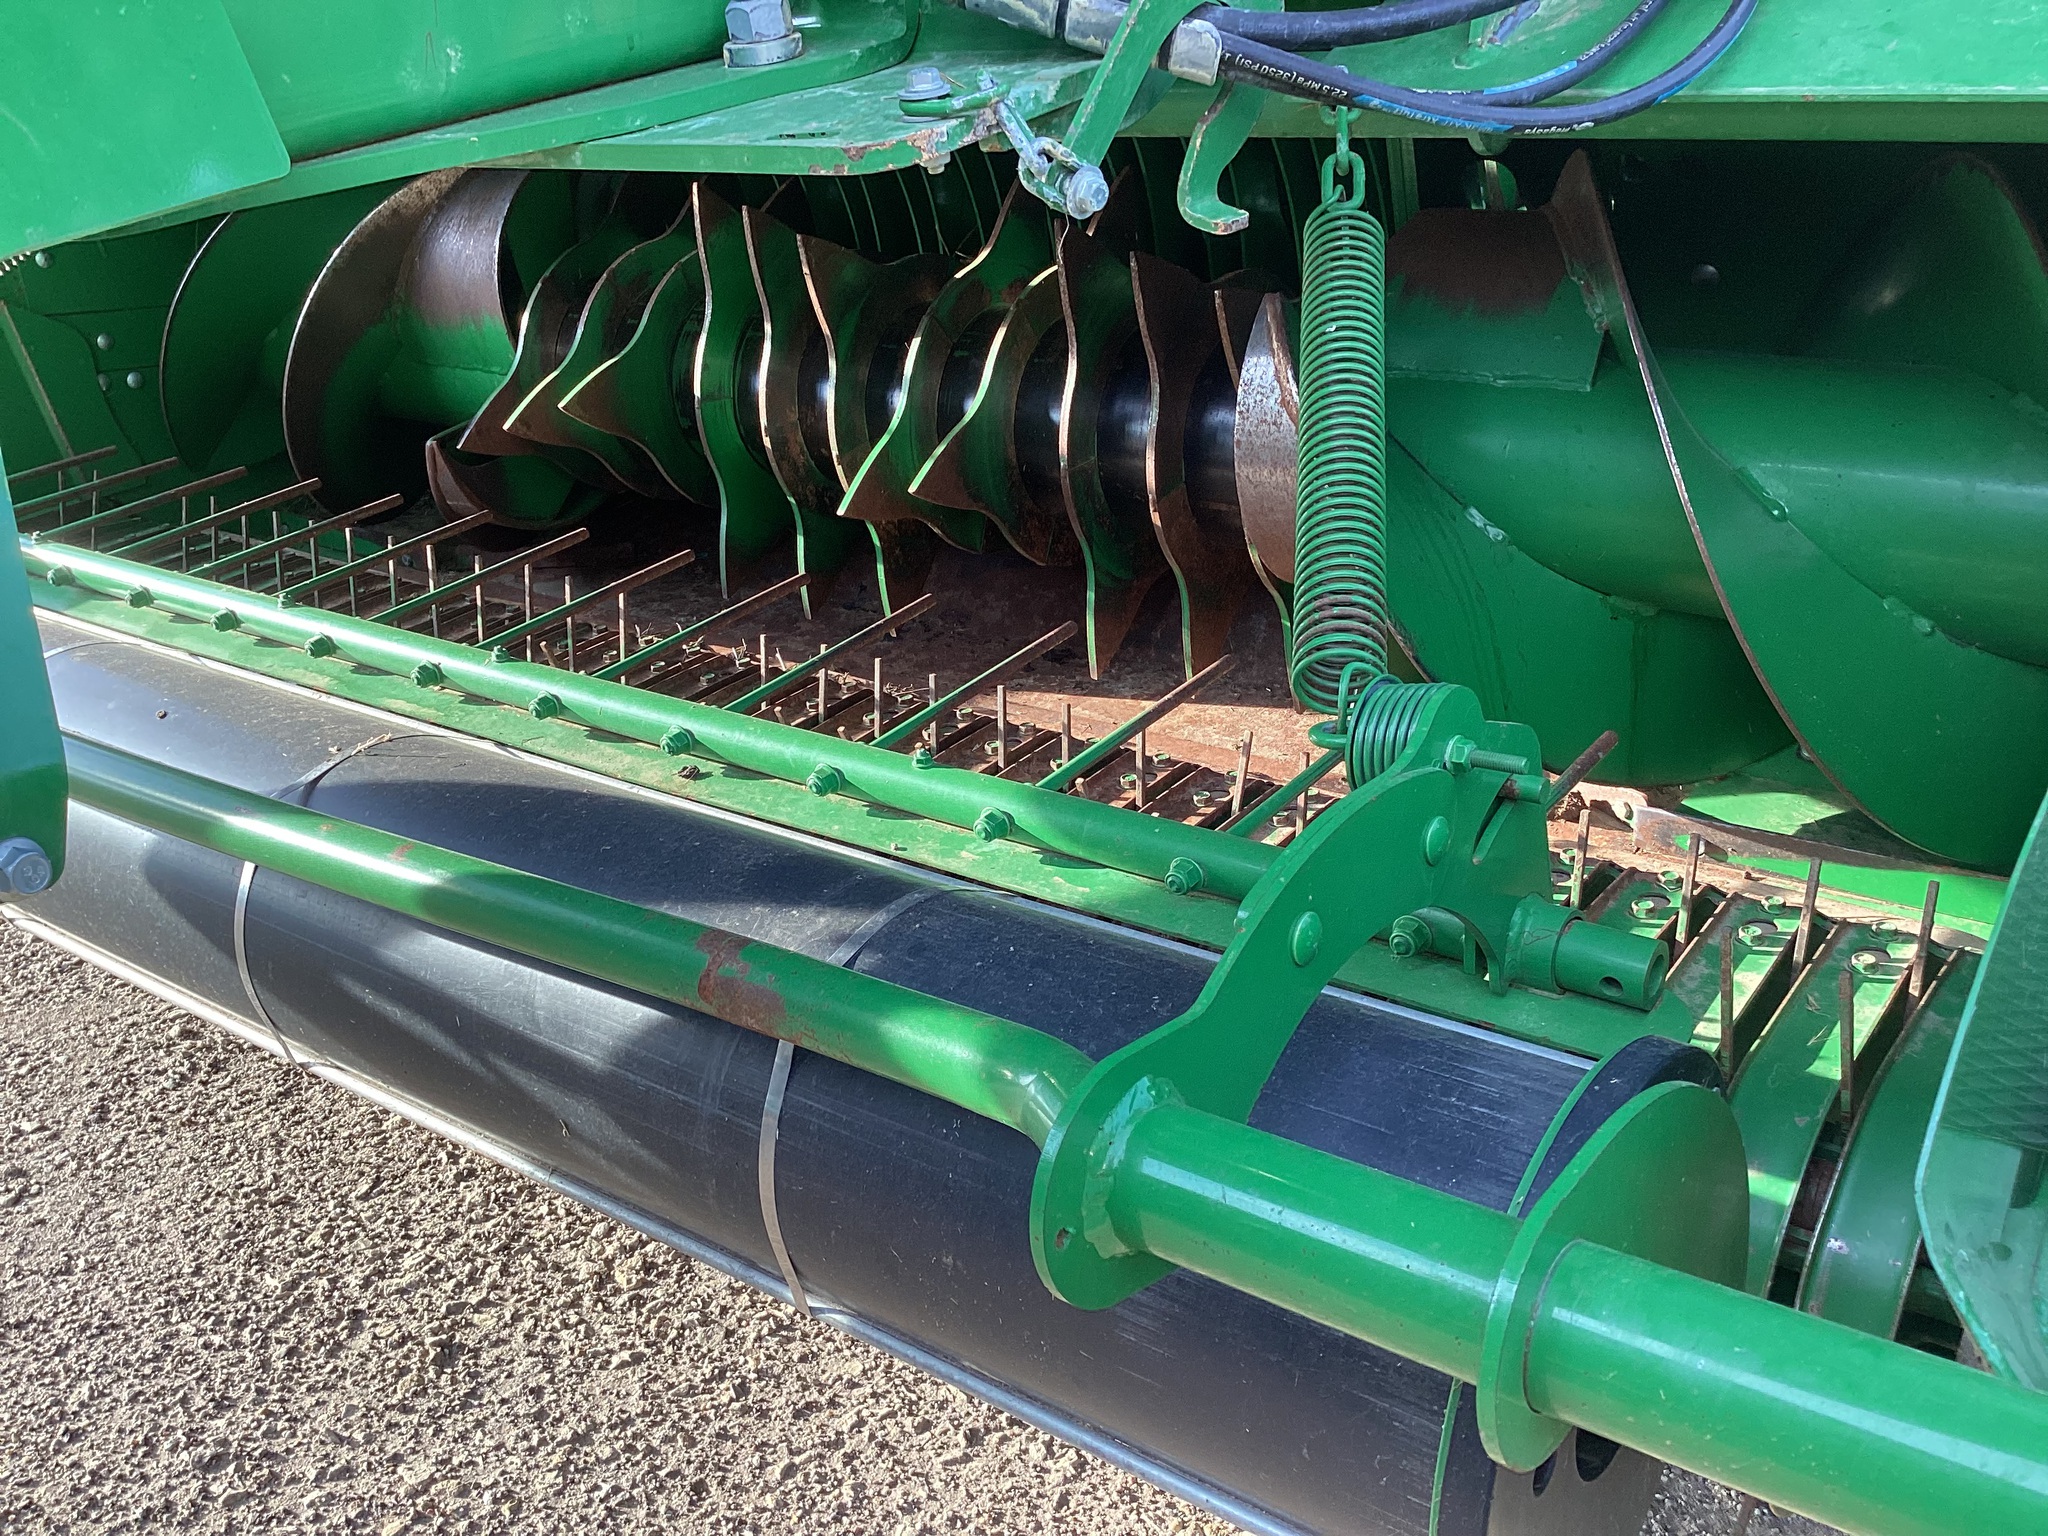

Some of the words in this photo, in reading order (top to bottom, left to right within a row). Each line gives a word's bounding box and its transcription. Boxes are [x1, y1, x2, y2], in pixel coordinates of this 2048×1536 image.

[1234, 53, 1261, 72] PSI)
[1296, 76, 1322, 91] MPa
[1322, 84, 1348, 99] 22.5
